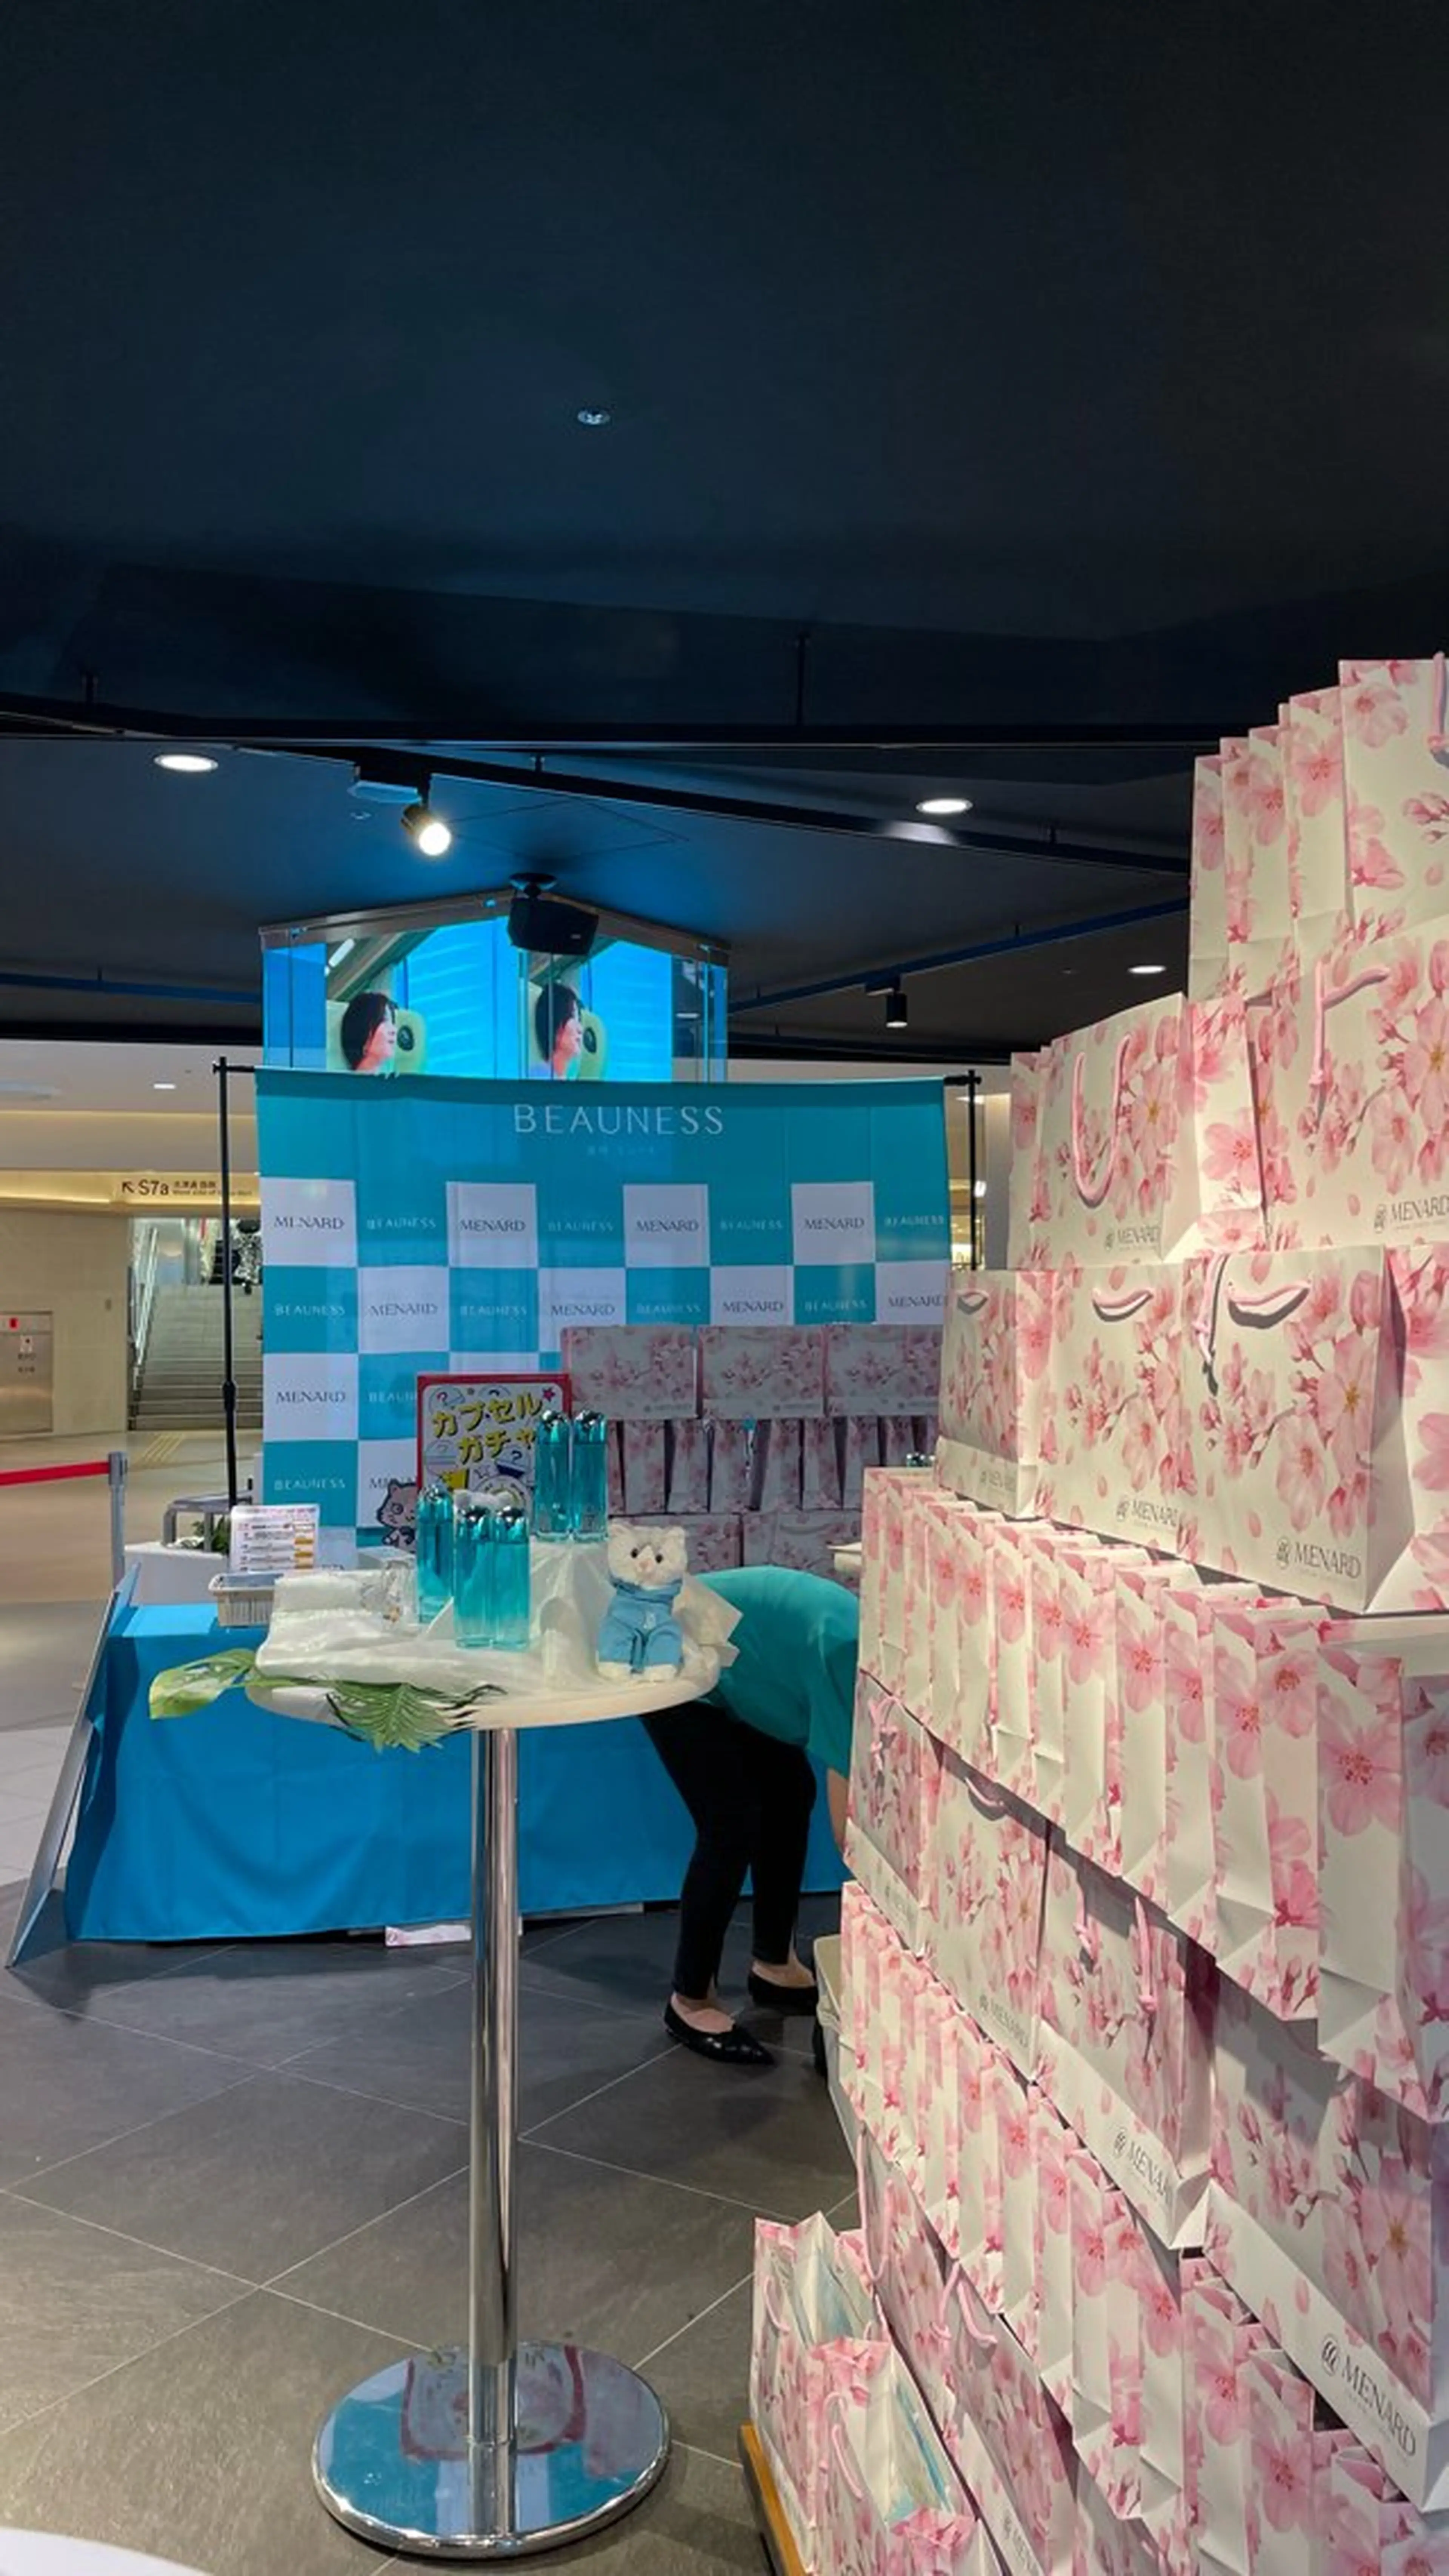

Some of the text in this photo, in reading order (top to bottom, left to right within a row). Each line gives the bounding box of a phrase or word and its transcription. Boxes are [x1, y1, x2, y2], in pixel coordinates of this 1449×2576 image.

[514, 1104, 724, 1135] BEAUNESS
[138, 1179, 169, 1195] S7a
[274, 1216, 345, 1230] MENARD
[460, 1219, 526, 1232] MENARD
[637, 1219, 699, 1232] MENARD
[804, 1216, 864, 1230] MENARD
[371, 1303, 438, 1316] MENARD
[551, 1303, 615, 1316] MENARD
[723, 1301, 784, 1313] MENARD
[276, 1391, 346, 1404] MENARD
[369, 1392, 415, 1402] BEAUN
[274, 1479, 346, 1490] BEAUNESS
[1294, 1541, 1361, 1578] MENARD
[1342, 2355, 1416, 2456] MENARD
